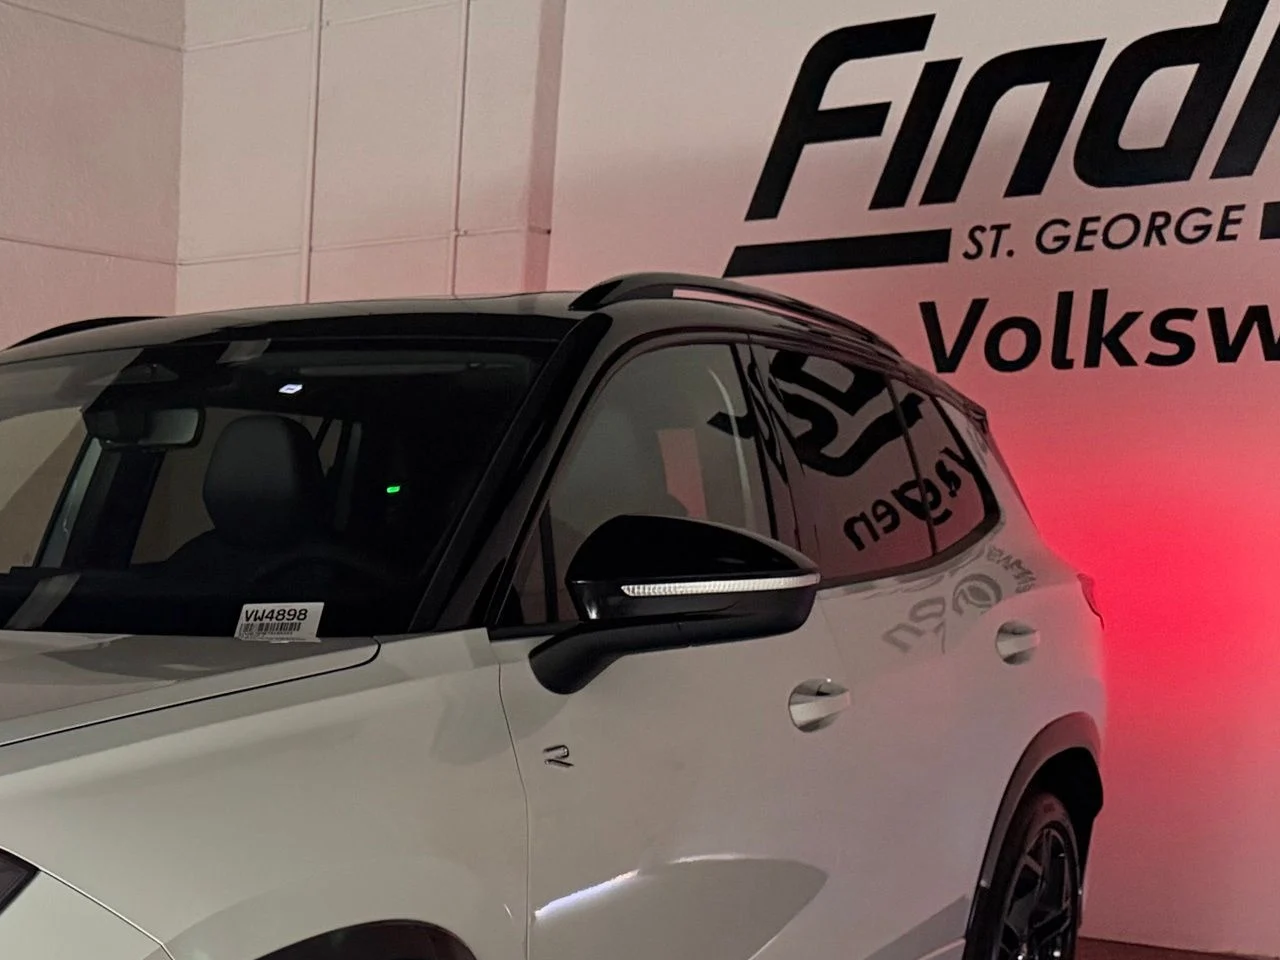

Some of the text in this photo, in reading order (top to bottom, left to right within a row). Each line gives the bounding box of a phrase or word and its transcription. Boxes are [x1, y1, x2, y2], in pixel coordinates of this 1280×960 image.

[962, 203, 1247, 260] ST. GEORGE
[245, 608, 308, 622] VW4898
